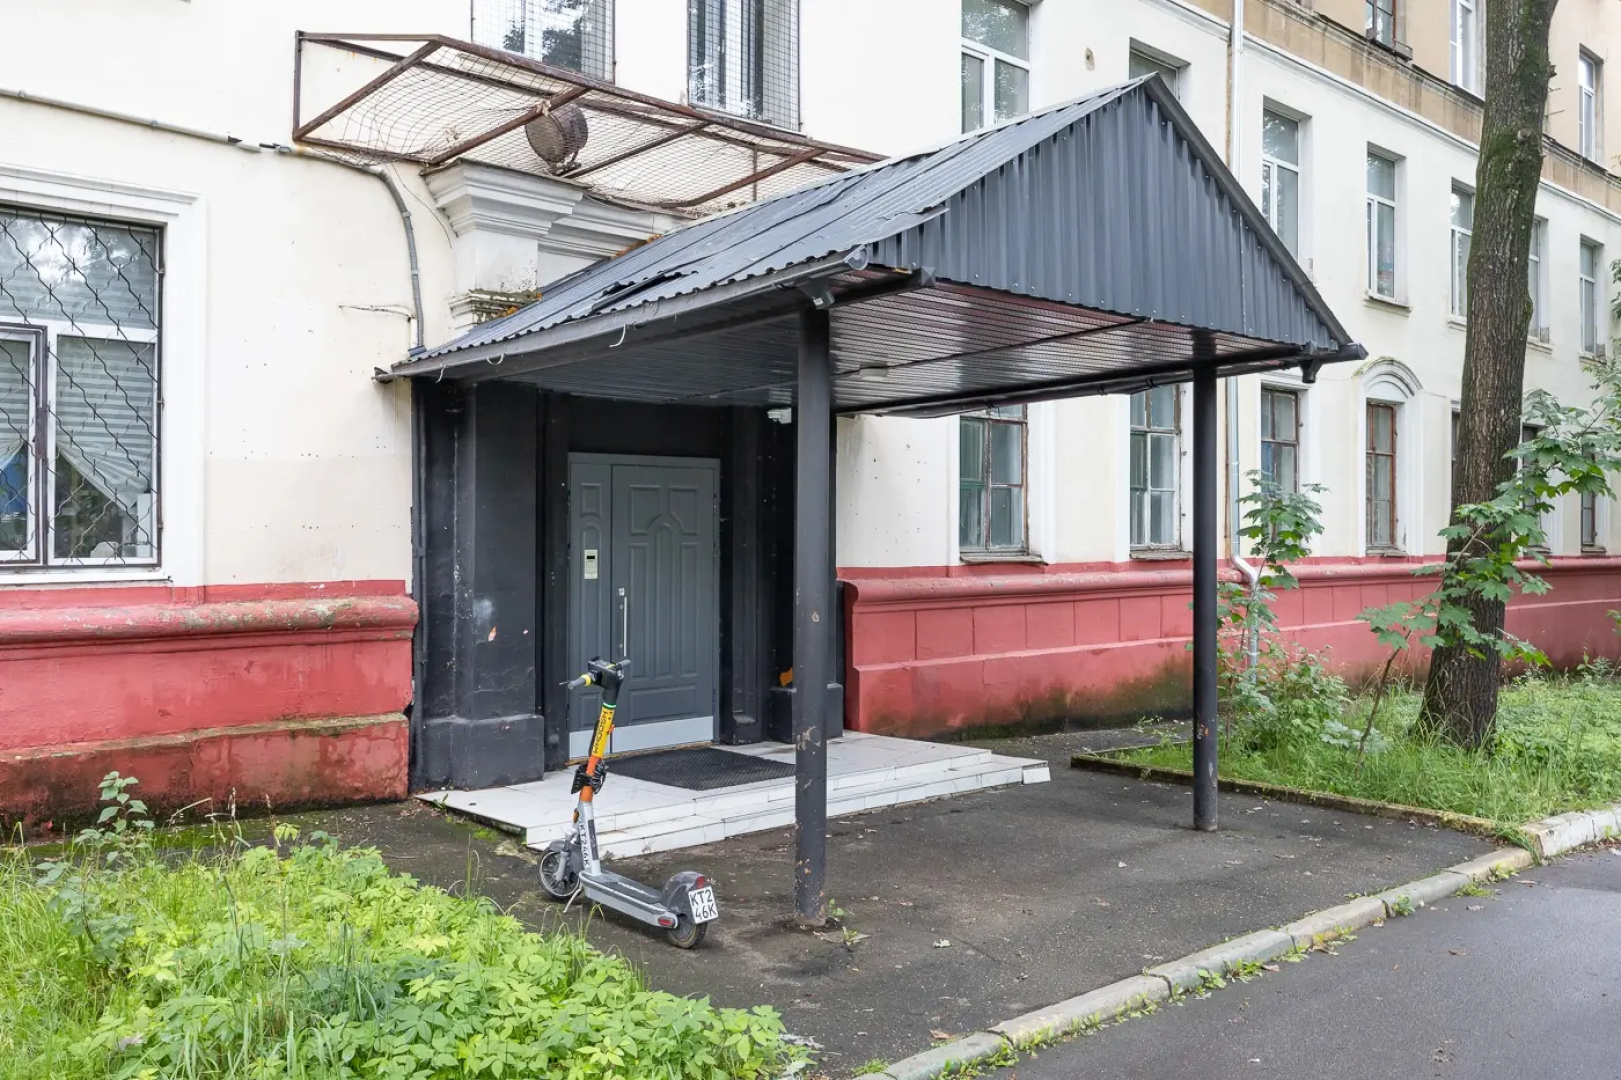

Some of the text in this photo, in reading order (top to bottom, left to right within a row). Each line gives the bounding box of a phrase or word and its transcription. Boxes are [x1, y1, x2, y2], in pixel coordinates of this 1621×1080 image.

[580, 824, 590, 866] KT246K
[690, 889, 712, 906] KT2
[695, 903, 717, 920] 46K
